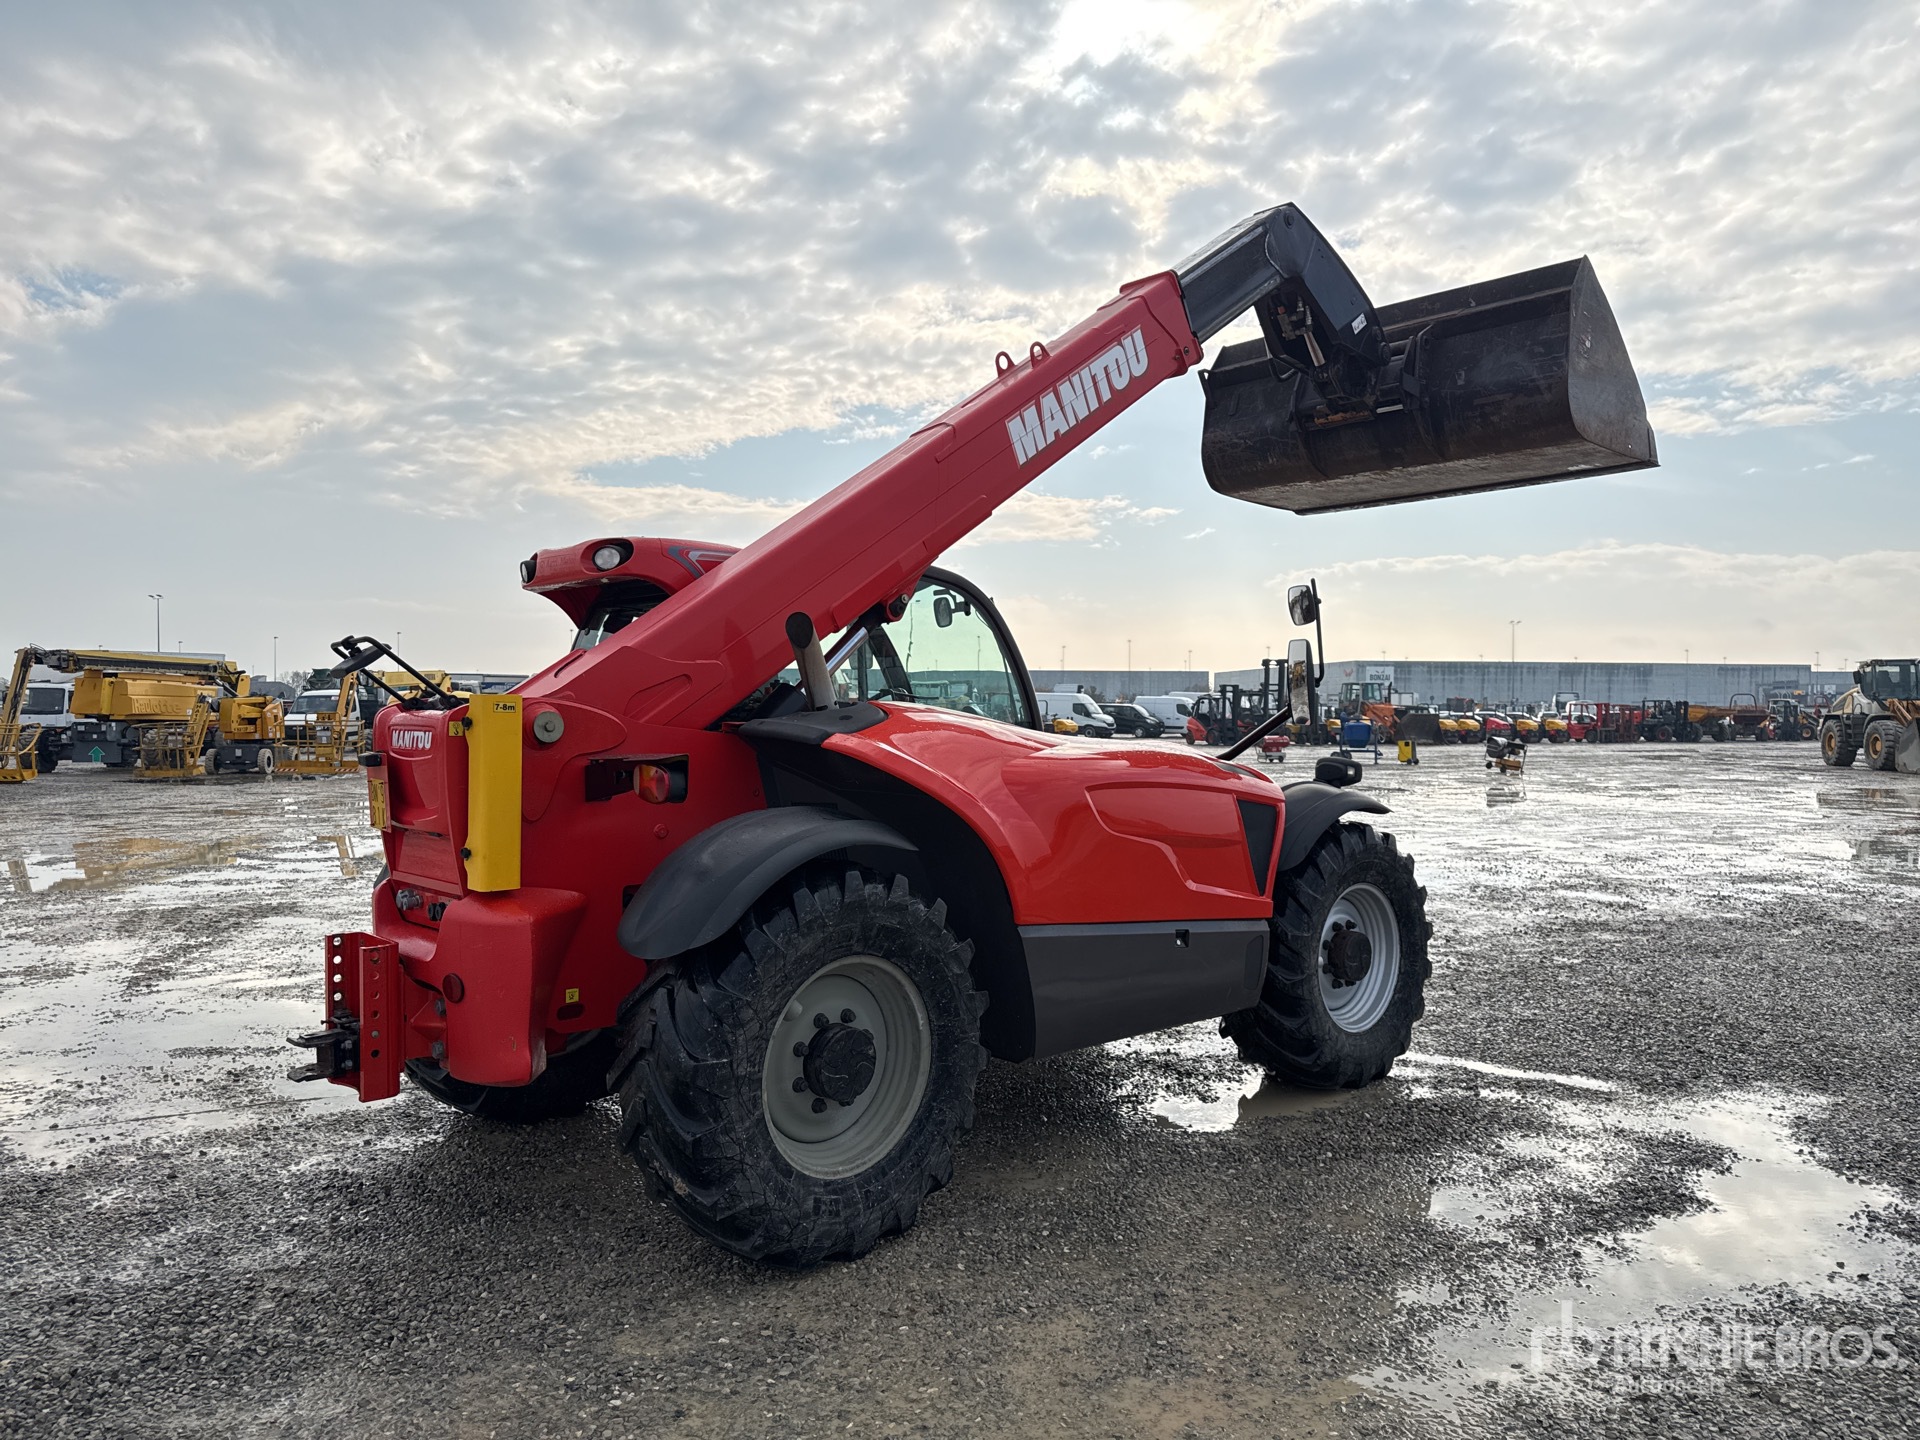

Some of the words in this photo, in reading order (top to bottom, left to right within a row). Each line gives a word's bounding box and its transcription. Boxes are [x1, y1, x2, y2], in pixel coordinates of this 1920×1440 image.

[1006, 327, 1148, 466] MANITOU
[494, 703, 515, 711] 7-8m
[391, 729, 433, 749] MANITOU
